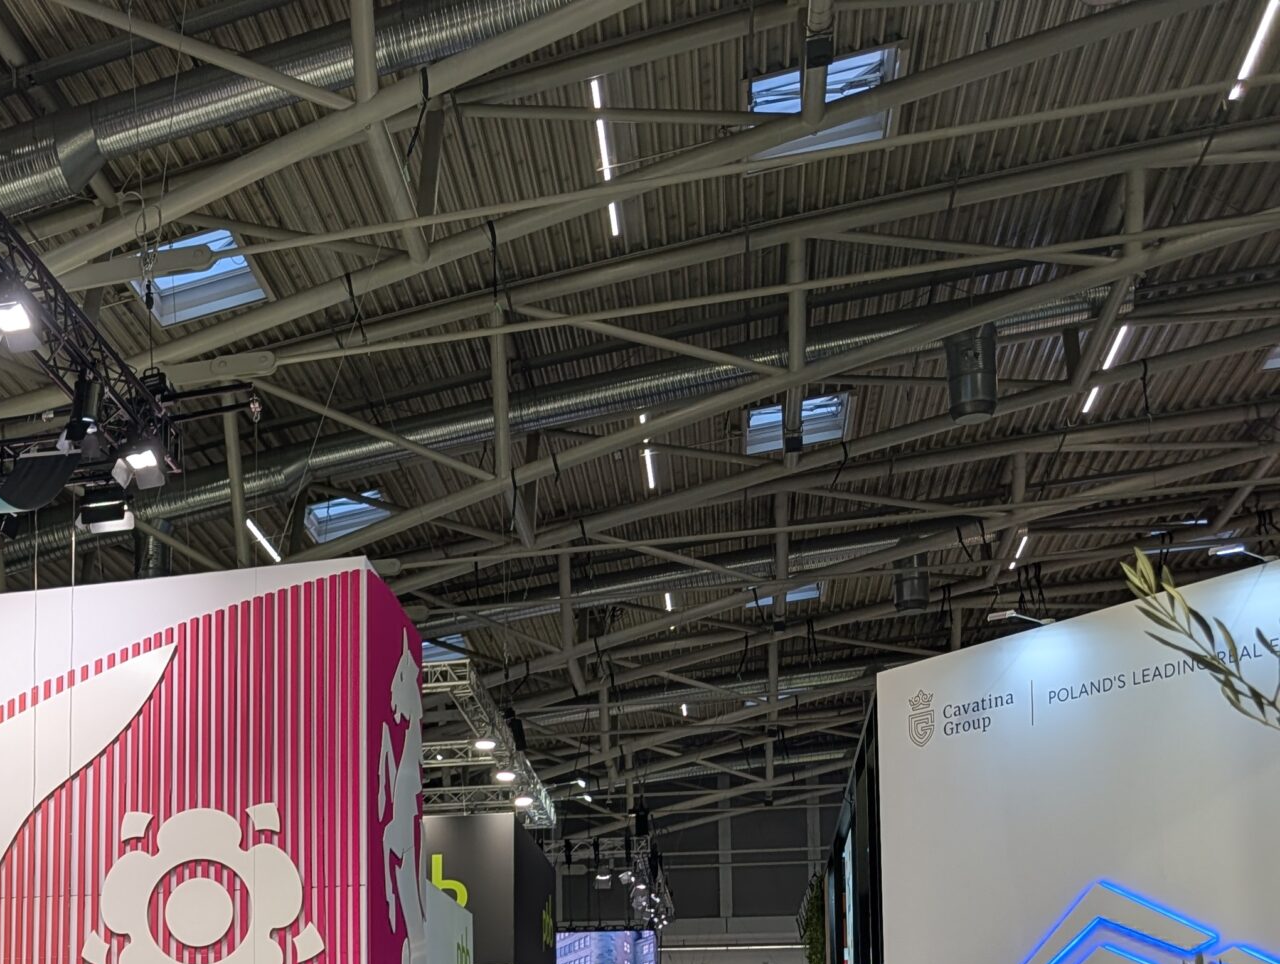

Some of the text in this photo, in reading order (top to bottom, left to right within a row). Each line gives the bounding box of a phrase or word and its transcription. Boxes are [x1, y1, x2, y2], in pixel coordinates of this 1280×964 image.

[1049, 674, 1126, 705] POLAND'S
[943, 691, 1014, 719] Cavatina
[944, 716, 991, 737] Group
